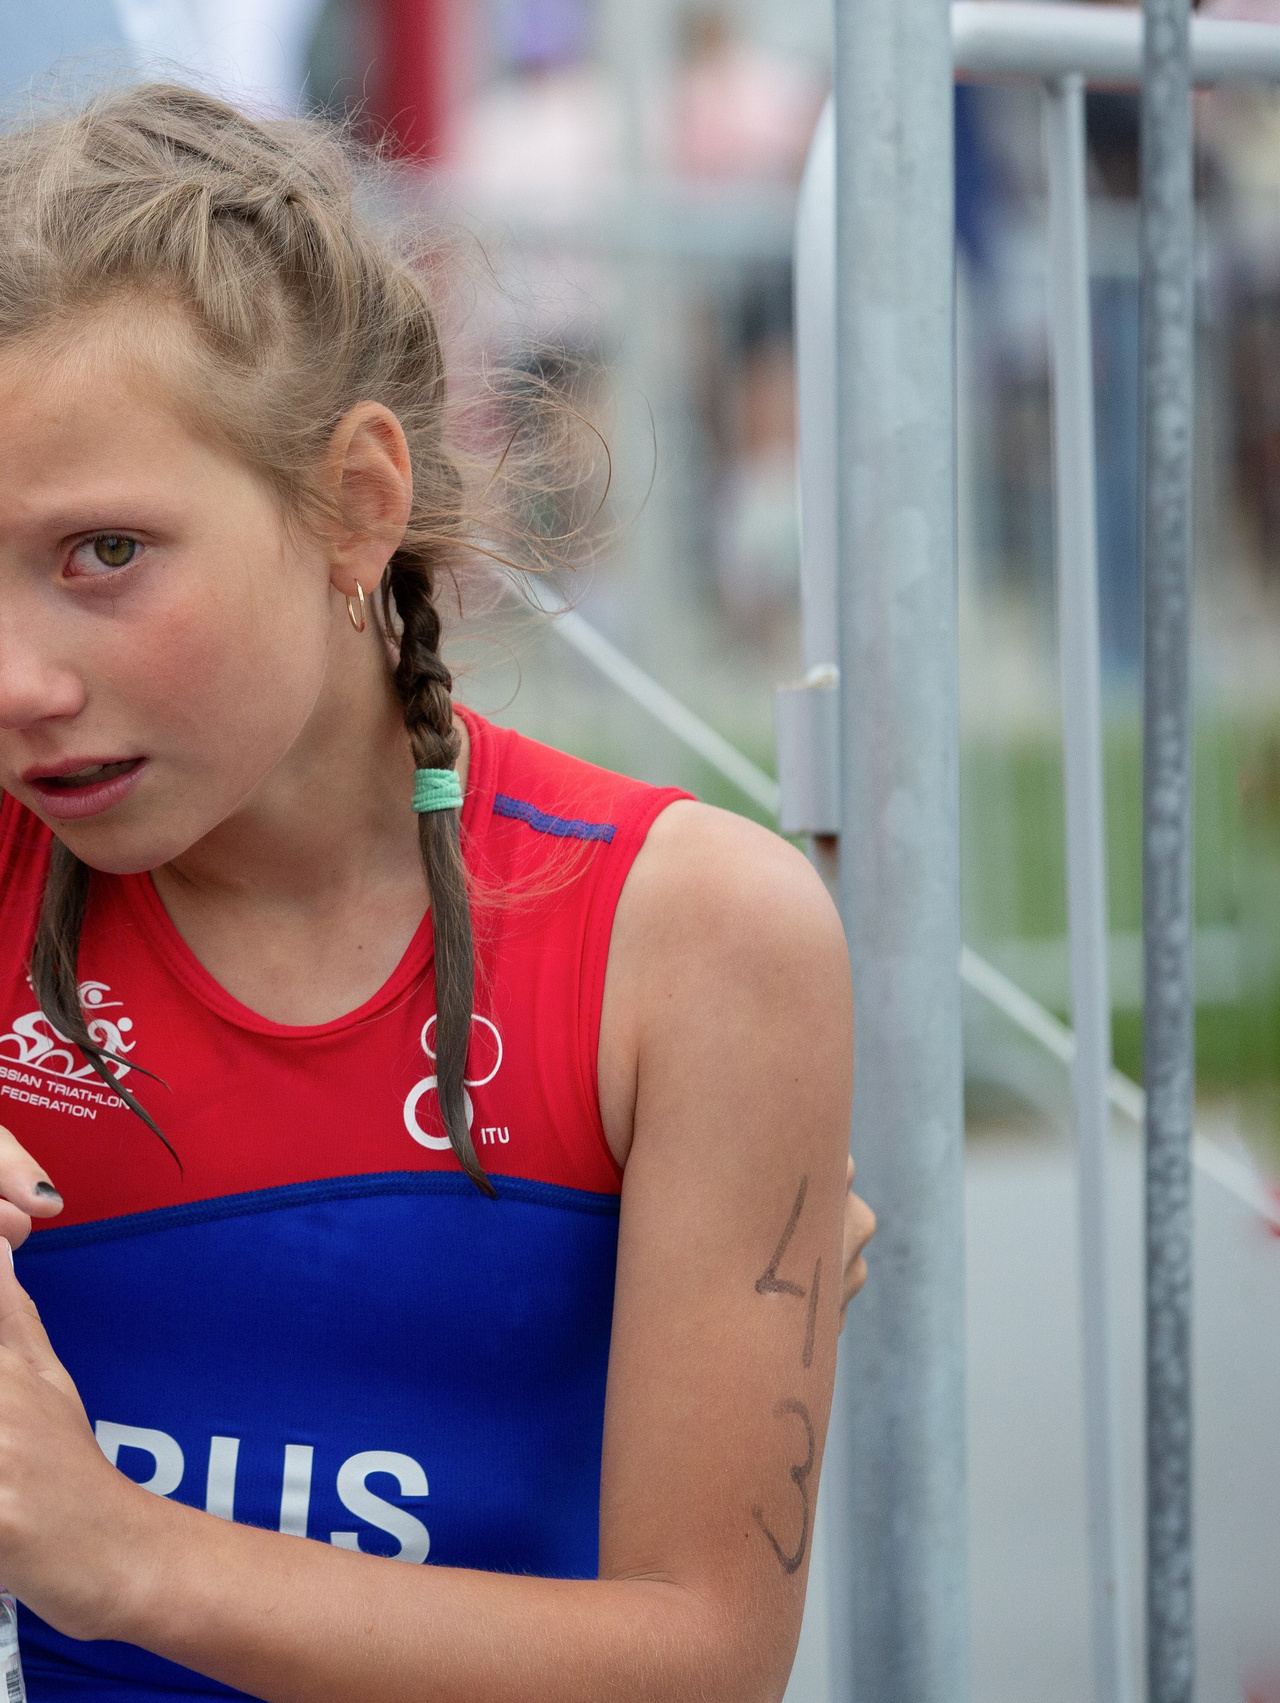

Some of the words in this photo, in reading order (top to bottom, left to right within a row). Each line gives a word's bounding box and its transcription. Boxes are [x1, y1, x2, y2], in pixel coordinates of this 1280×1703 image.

[0, 1085, 97, 1119] FEDERATION
[46, 1080, 131, 1111] TRIATHLON
[481, 1127, 510, 1145] ITU
